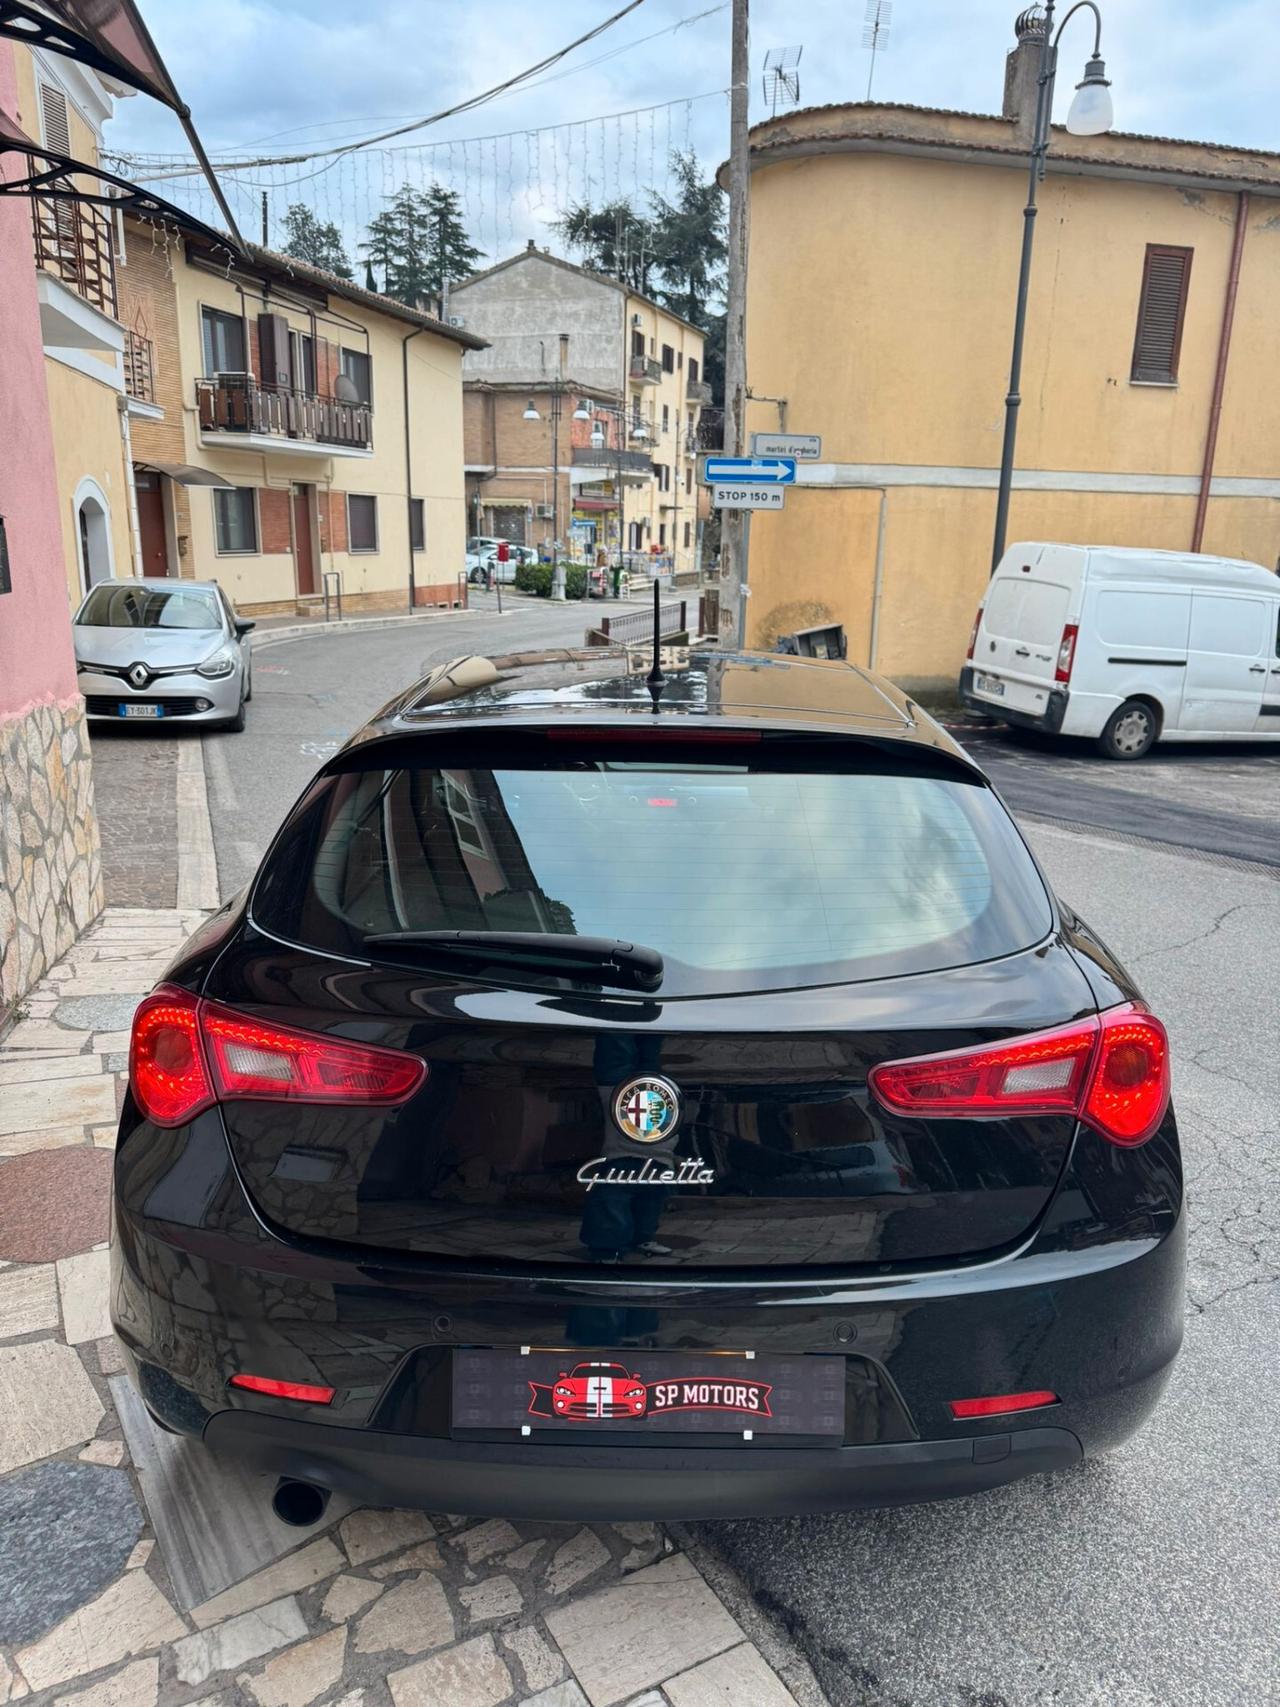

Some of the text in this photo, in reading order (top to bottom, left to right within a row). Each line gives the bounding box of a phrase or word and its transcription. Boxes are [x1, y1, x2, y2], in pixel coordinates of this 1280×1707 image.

[718, 491, 781, 502] STOP 150 m
[620, 1083, 674, 1112] ALFA ROMEO
[576, 1157, 715, 1193] Giulietta
[655, 1384, 760, 1410] SP MOTORS
